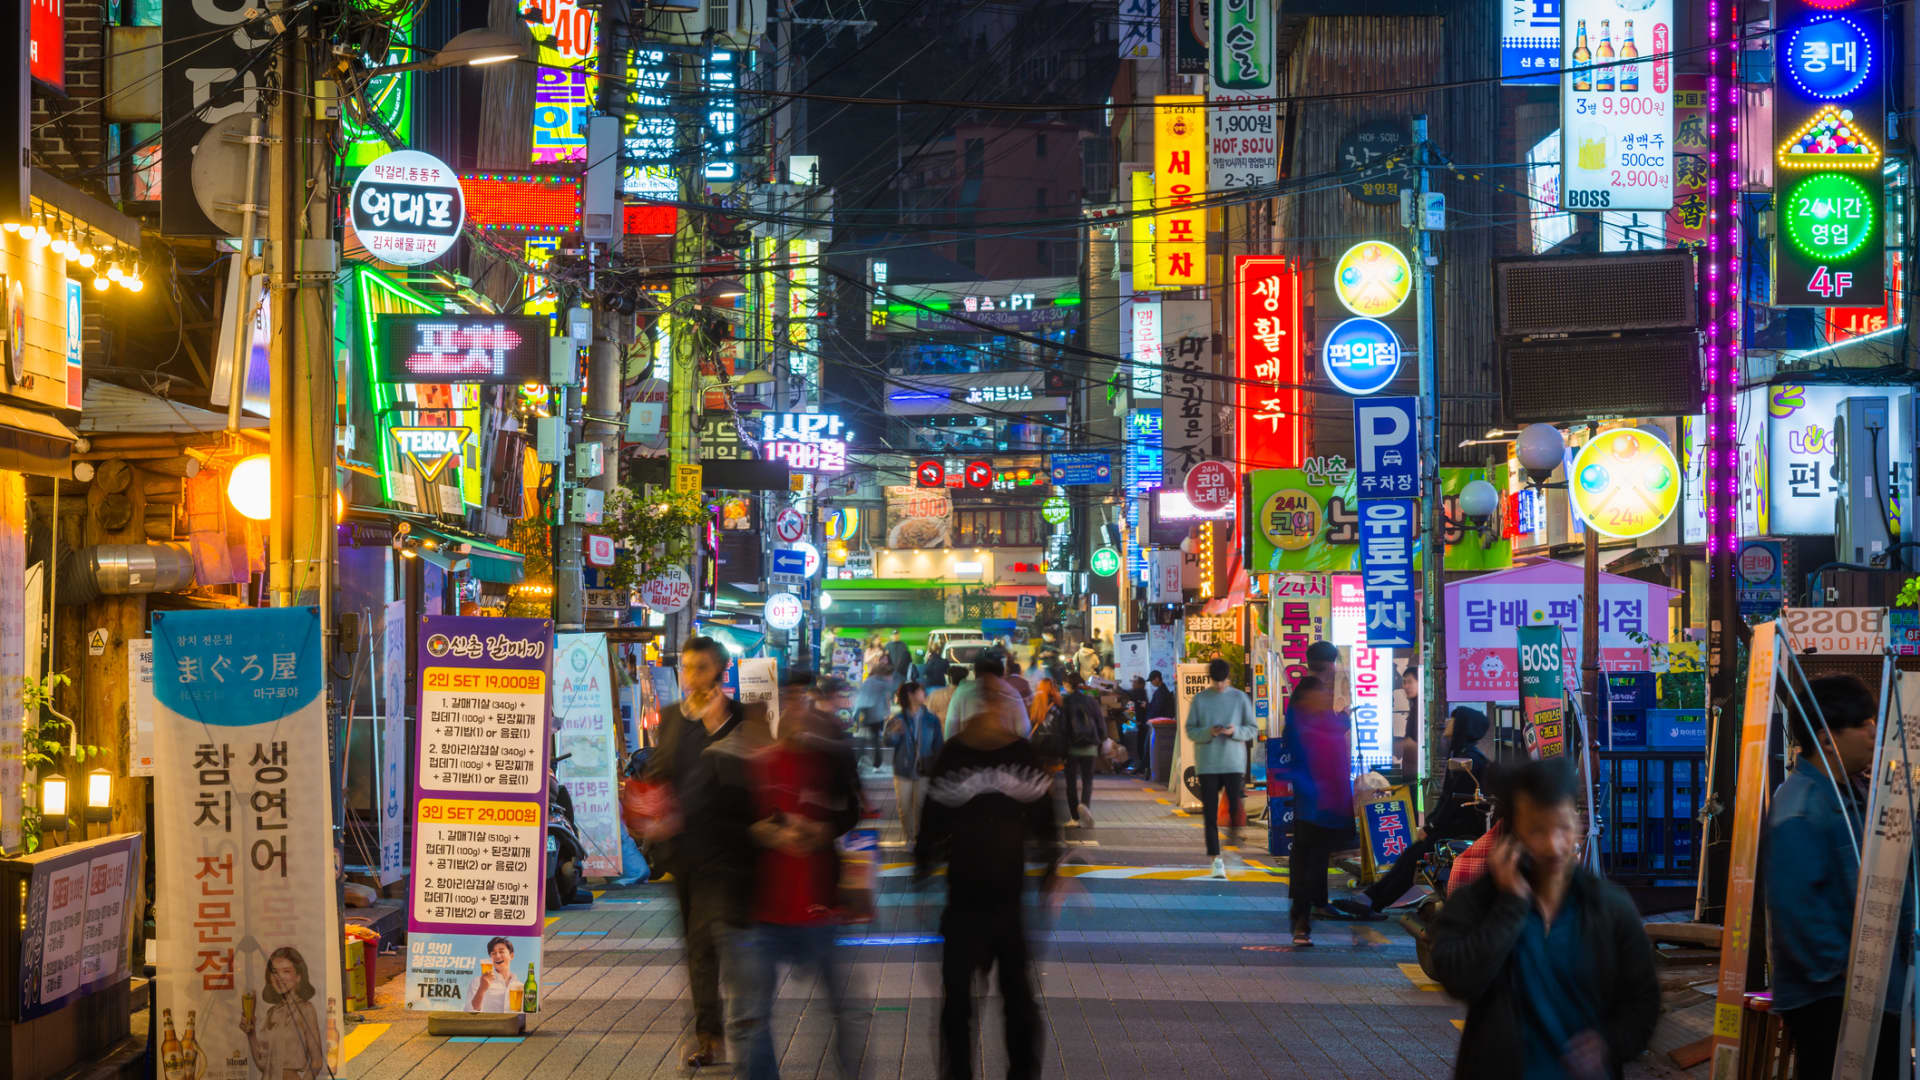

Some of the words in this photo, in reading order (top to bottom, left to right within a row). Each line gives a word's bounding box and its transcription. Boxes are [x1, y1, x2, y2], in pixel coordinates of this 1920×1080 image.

[555, 9, 593, 57] 40
[1801, 41, 1857, 73] 중대
[1576, 97, 1597, 116] 3병
[1602, 96, 1665, 117] 9,900원
[1215, 114, 1273, 135] 1,900원
[1621, 133, 1666, 150] 생맥주
[1621, 153, 1665, 167] 500cc
[1224, 173, 1264, 188] 2~3F
[1610, 169, 1669, 189] 2,900원
[360, 187, 454, 227] 연대포
[1568, 190, 1610, 208] BOSS
[1799, 198, 1862, 219] 24시간
[1167, 150, 1194, 278] 서울포차
[373, 235, 437, 254] 김치해물파전
[1811, 224, 1848, 246] 영업
[1807, 266, 1853, 298] 4F
[1251, 274, 1287, 435] 생활맥주
[1329, 342, 1396, 368] 편의점
[396, 430, 461, 455] TERRA
[1358, 405, 1411, 473] P
[1303, 455, 1349, 486] 신촌
[1197, 473, 1225, 488] 코인
[1361, 473, 1413, 492] 주차장
[1195, 488, 1230, 503] 노래방
[1275, 496, 1307, 511] 24시
[1270, 511, 1315, 536] 코인
[1364, 504, 1412, 632] 유료주차
[1278, 576, 1327, 597] 24시
[1466, 599, 1528, 632] 담배
[450, 634, 484, 659] 신촌
[487, 633, 545, 661] 갈매기
[1521, 643, 1560, 672] BOSS
[177, 651, 298, 684] まぐろ屋
[428, 673, 449, 687] 2인
[453, 674, 480, 688] SET
[1185, 675, 1210, 685] CRAFT
[254, 686, 299, 700] 마구로야
[451, 697, 490, 710] 갈매기살
[492, 700, 518, 711] (340g)
[431, 711, 460, 723] 껍데기
[462, 714, 485, 724] (100g)
[496, 714, 536, 725] 된장찌개
[486, 729, 497, 738] or
[441, 744, 499, 757] 항아리삼겹살
[501, 748, 526, 758] (340g)
[429, 757, 458, 769] 껍데기
[460, 760, 483, 770] (100g)
[495, 760, 534, 771] 된장찌개
[193, 743, 236, 832] 참치
[484, 776, 495, 785] or
[248, 740, 288, 878] 생연어
[422, 805, 443, 819] 3인
[447, 807, 474, 820] SET
[447, 830, 486, 842] 갈매기살
[1379, 814, 1408, 857] 주차
[426, 844, 455, 855] 껍데기
[456, 847, 480, 856] (100g)
[491, 846, 531, 858] 된장찌개
[481, 862, 492, 871] or
[437, 877, 495, 890] 항아리삼겹살
[424, 892, 453, 903] 껍데기
[455, 895, 479, 905] (100g)
[490, 894, 529, 906] 된장찌개
[193, 853, 236, 991] 전문점
[479, 910, 490, 919] or
[417, 983, 462, 1000] TERRA
